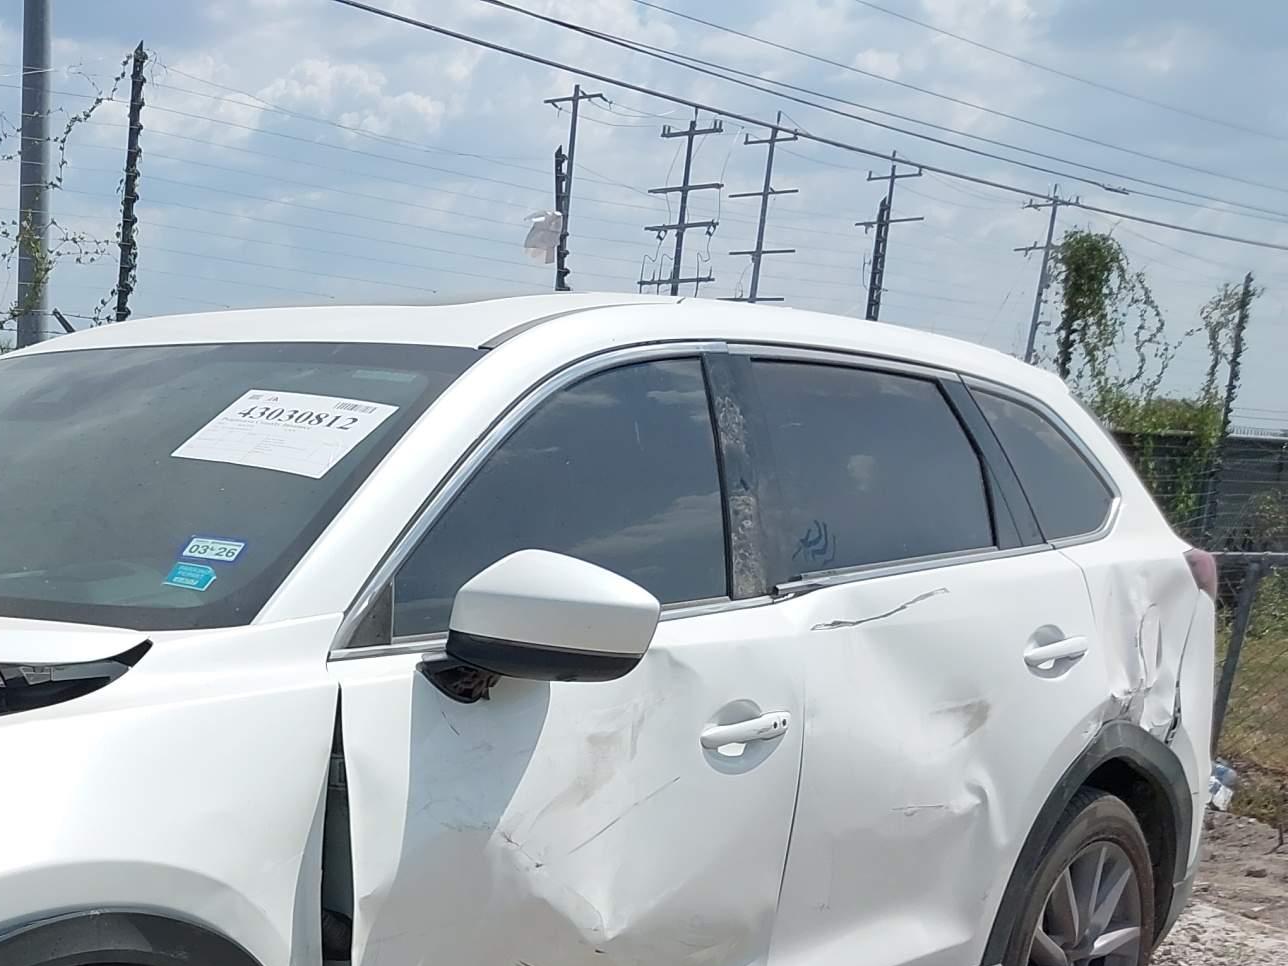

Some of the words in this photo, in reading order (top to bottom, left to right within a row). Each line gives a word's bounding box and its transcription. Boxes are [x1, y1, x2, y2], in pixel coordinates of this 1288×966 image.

[238, 405, 360, 430] 43030812
[188, 544, 210, 555] 03
[215, 547, 238, 558] 26
